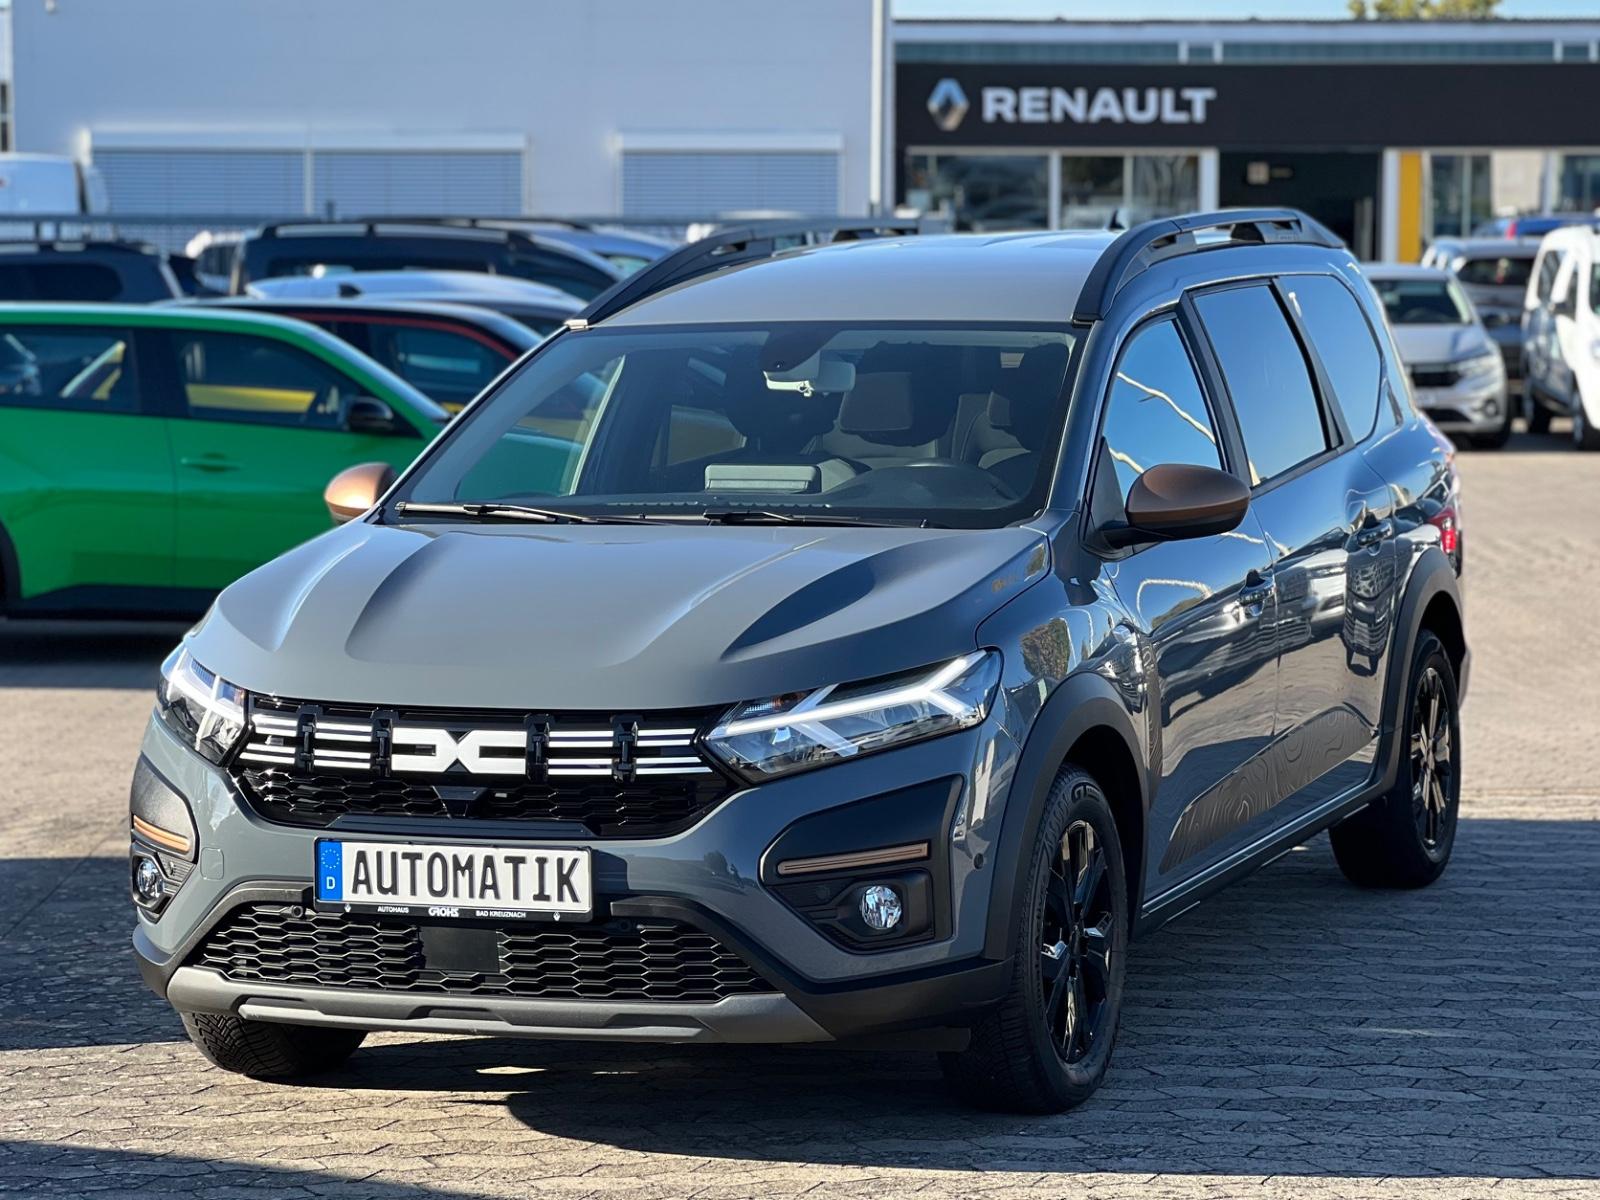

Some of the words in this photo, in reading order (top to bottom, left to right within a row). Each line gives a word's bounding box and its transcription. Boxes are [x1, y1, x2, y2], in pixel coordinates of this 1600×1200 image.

[981, 86, 1217, 123] RENAULT
[326, 876, 335, 890] D
[351, 850, 581, 903] AUTOMATIK
[377, 905, 409, 914] AUTOHAUS
[428, 906, 459, 917] GROHS
[490, 910, 526, 919] KREUZNACH
